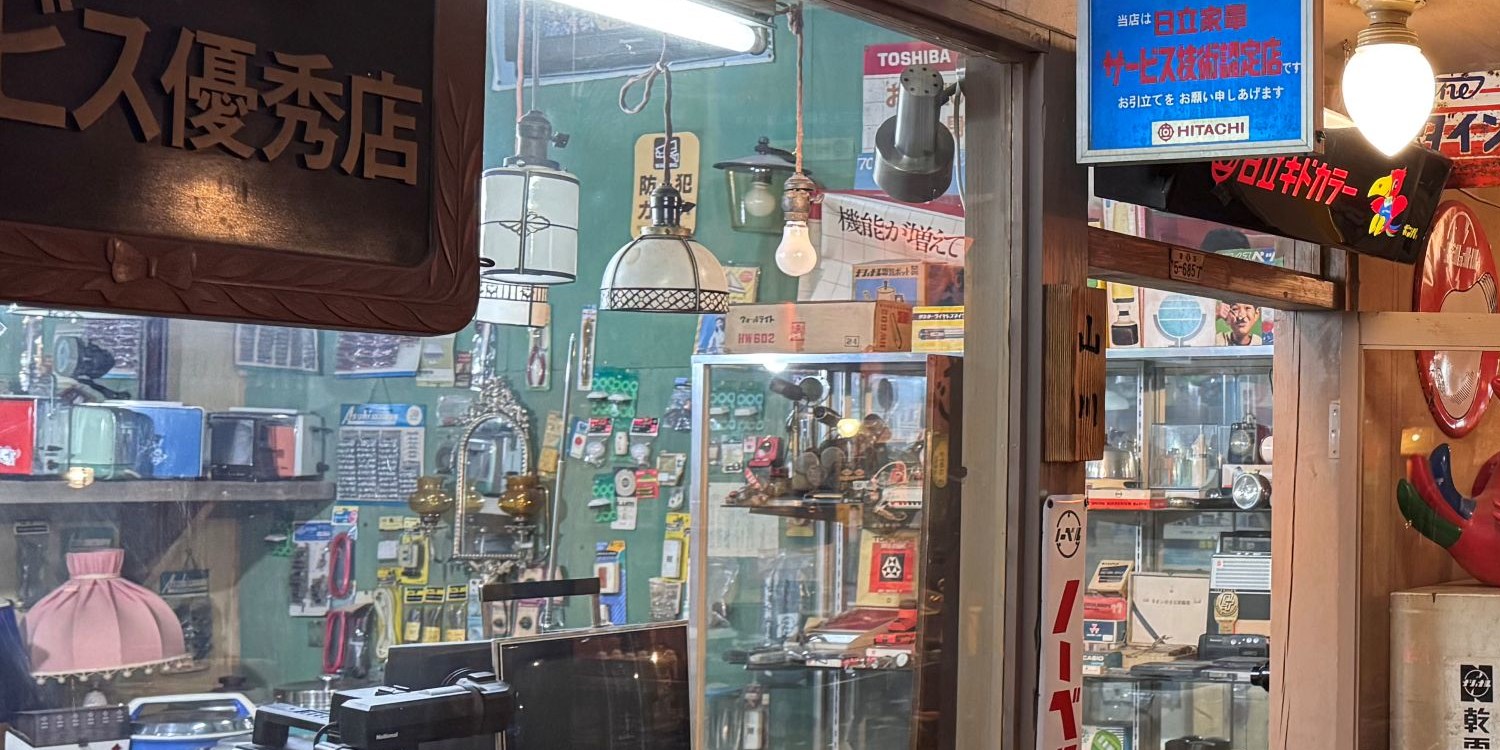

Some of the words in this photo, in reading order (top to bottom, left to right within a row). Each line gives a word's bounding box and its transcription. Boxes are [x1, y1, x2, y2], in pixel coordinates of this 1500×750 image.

[877, 49, 951, 66] TOSHIBA
[1117, 94, 1174, 109] お引立てを
[1179, 86, 1284, 105] お願い申しあげます
[1177, 122, 1245, 137] HITACHI
[837, 205, 966, 258] 機能が増えて
[738, 333, 775, 344] HW602
[1049, 579, 1080, 750] ノーベ
